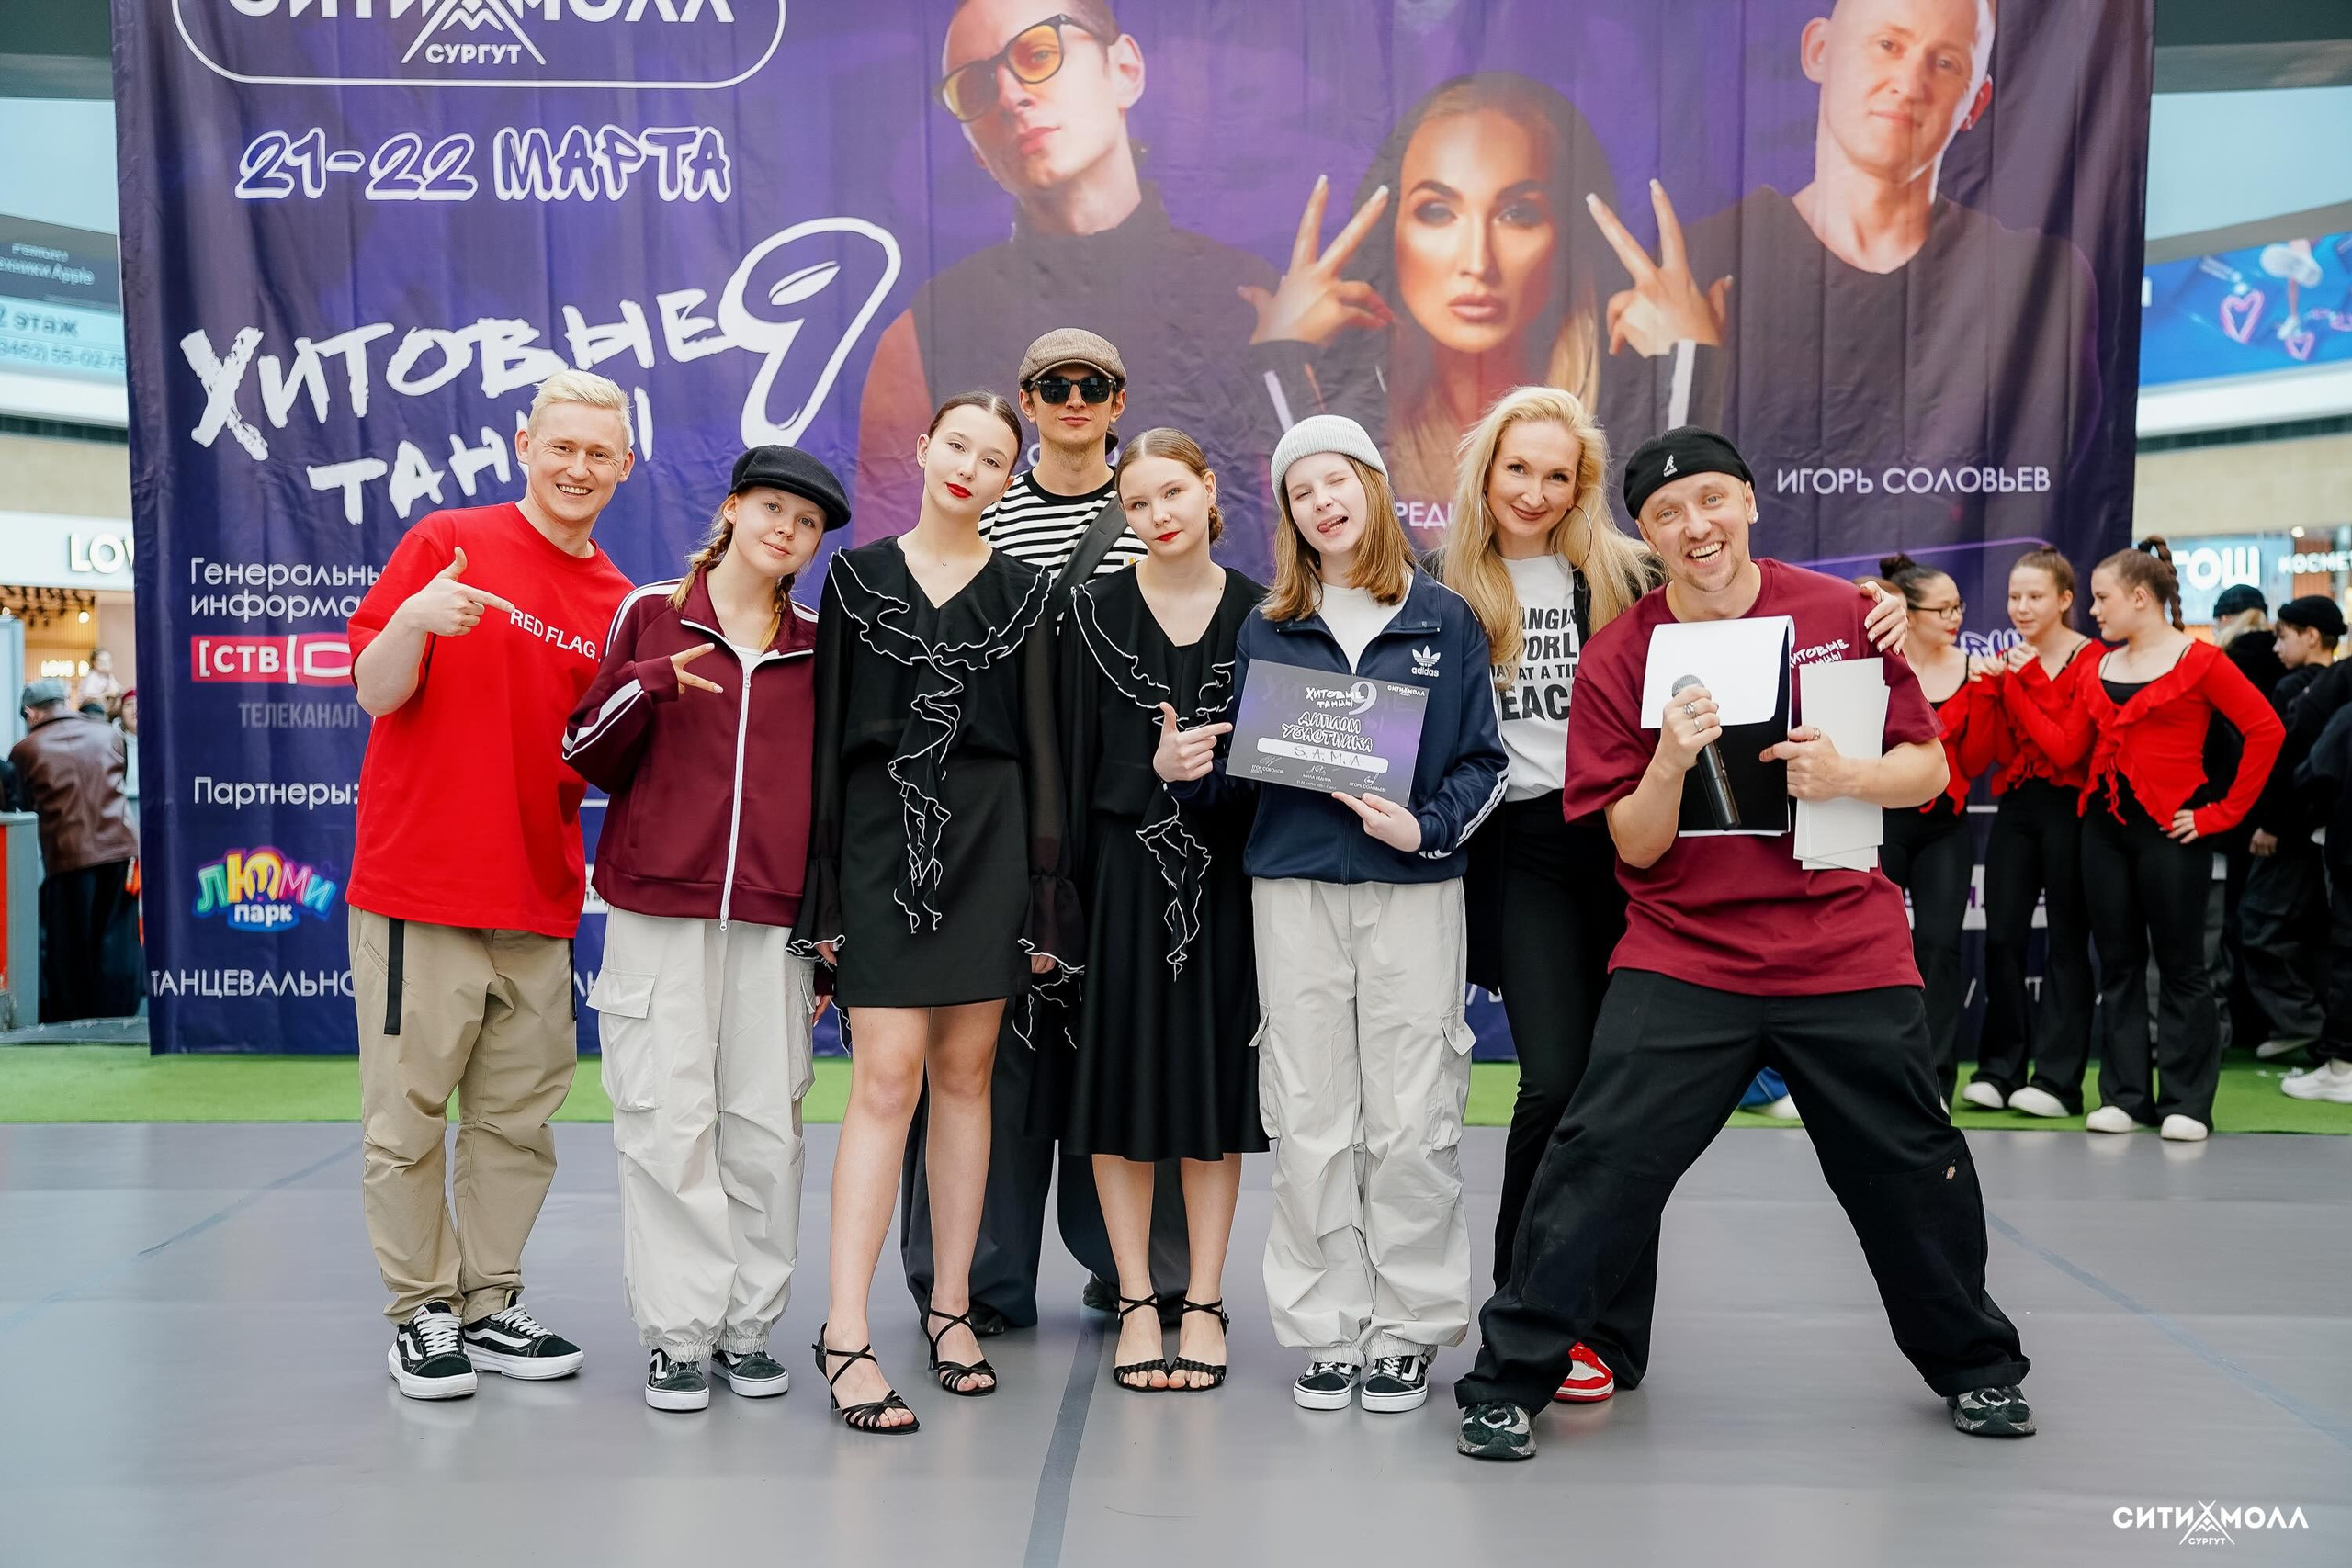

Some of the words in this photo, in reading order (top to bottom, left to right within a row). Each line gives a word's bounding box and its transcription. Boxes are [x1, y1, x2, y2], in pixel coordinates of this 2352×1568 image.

[424, 42, 522, 66] СУРГУТ
[234, 127, 479, 201] 21-22
[492, 123, 732, 203] МАРТА
[179, 289, 724, 461] ХИТОВЫЕ
[1776, 467, 1875, 495] ИГОРЬ
[1882, 466, 2052, 494] СОЛОВЬЕВ
[190, 588, 364, 624] информа
[509, 608, 544, 637] RED
[1790, 639, 1849, 668] ИТОВЫЕ
[1411, 666, 1440, 678] adidas
[1519, 666, 1534, 680] AT
[1541, 665, 1551, 679] A
[1305, 686, 1365, 702] ХИТОВЫЕ
[1348, 681, 1377, 716] 9
[1500, 683, 1572, 721] EAC
[239, 702, 359, 728] ТЕЛЕКАНАЛ
[1298, 710, 1362, 734] ДИПЛОМ
[1282, 723, 1374, 752] УЧАСТНИКА
[194, 776, 359, 810] Партнеры:
[196, 852, 337, 913] ЛЮМИ
[233, 903, 293, 928] парк
